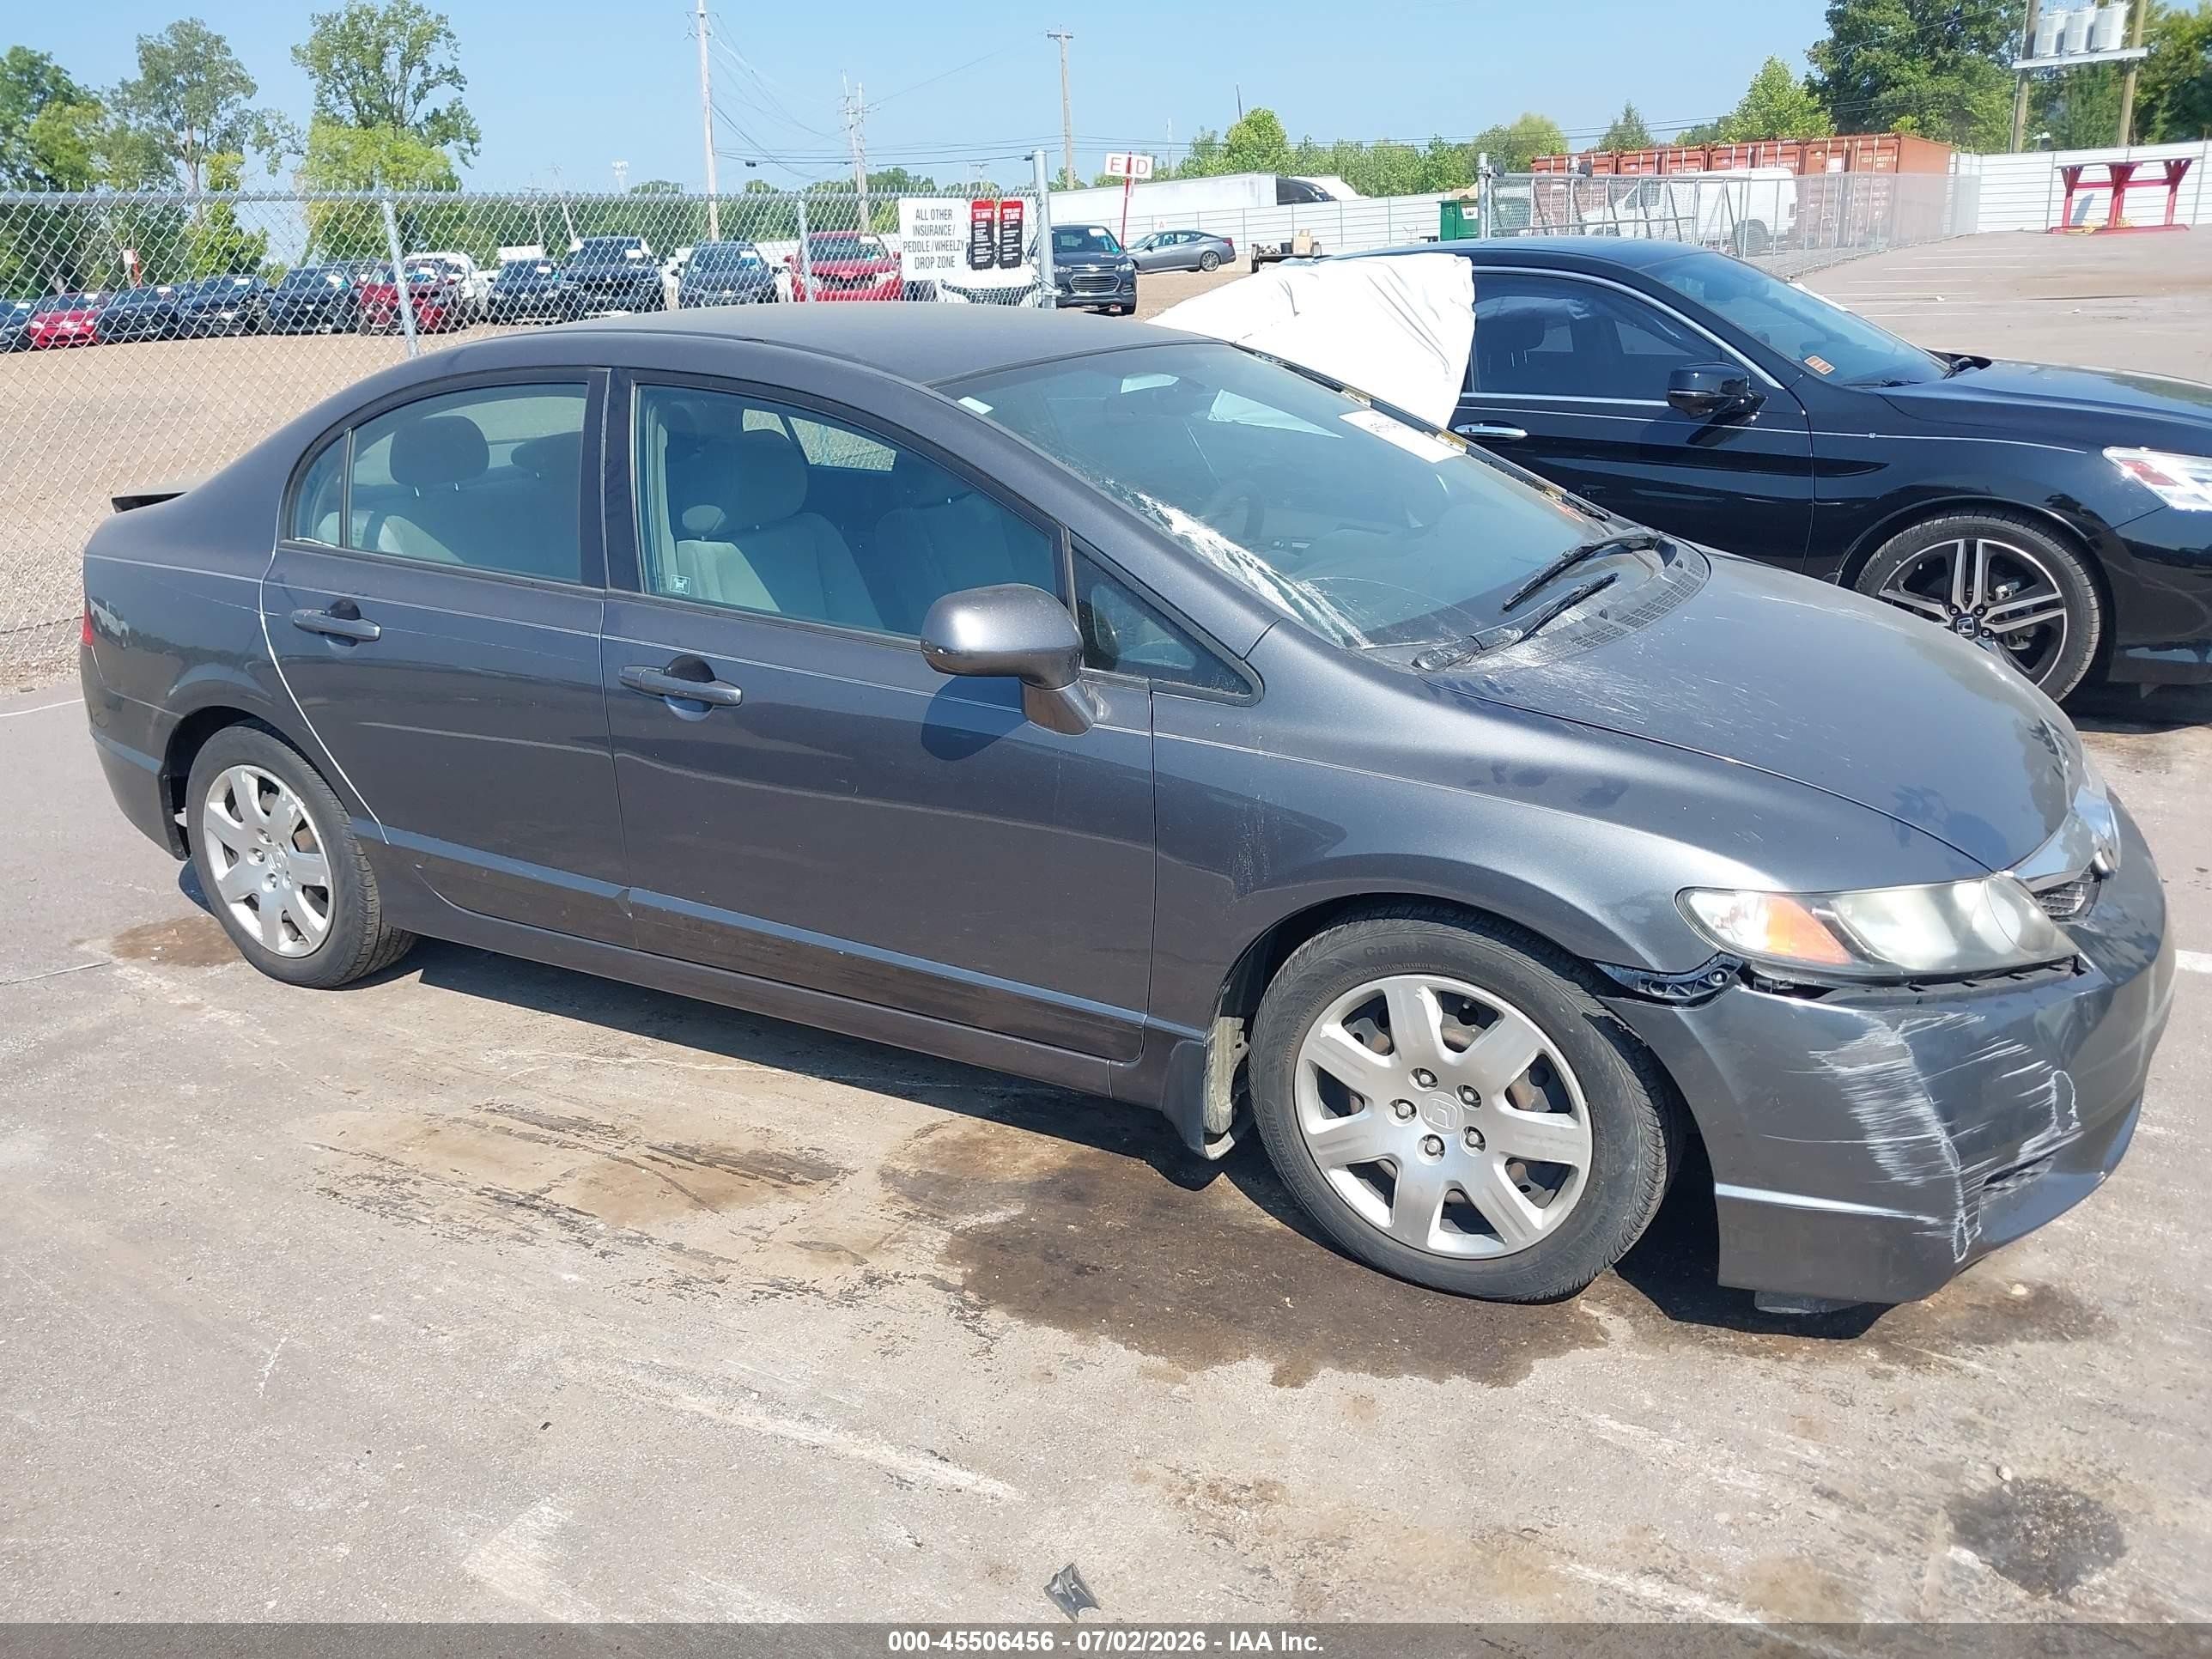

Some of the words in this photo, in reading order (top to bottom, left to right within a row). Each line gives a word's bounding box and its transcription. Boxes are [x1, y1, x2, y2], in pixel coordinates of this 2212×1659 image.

[915, 209, 929, 221] ALL
[930, 209, 953, 221] OTHER
[915, 257, 935, 270] DROP
[937, 256, 956, 269] ZONE
